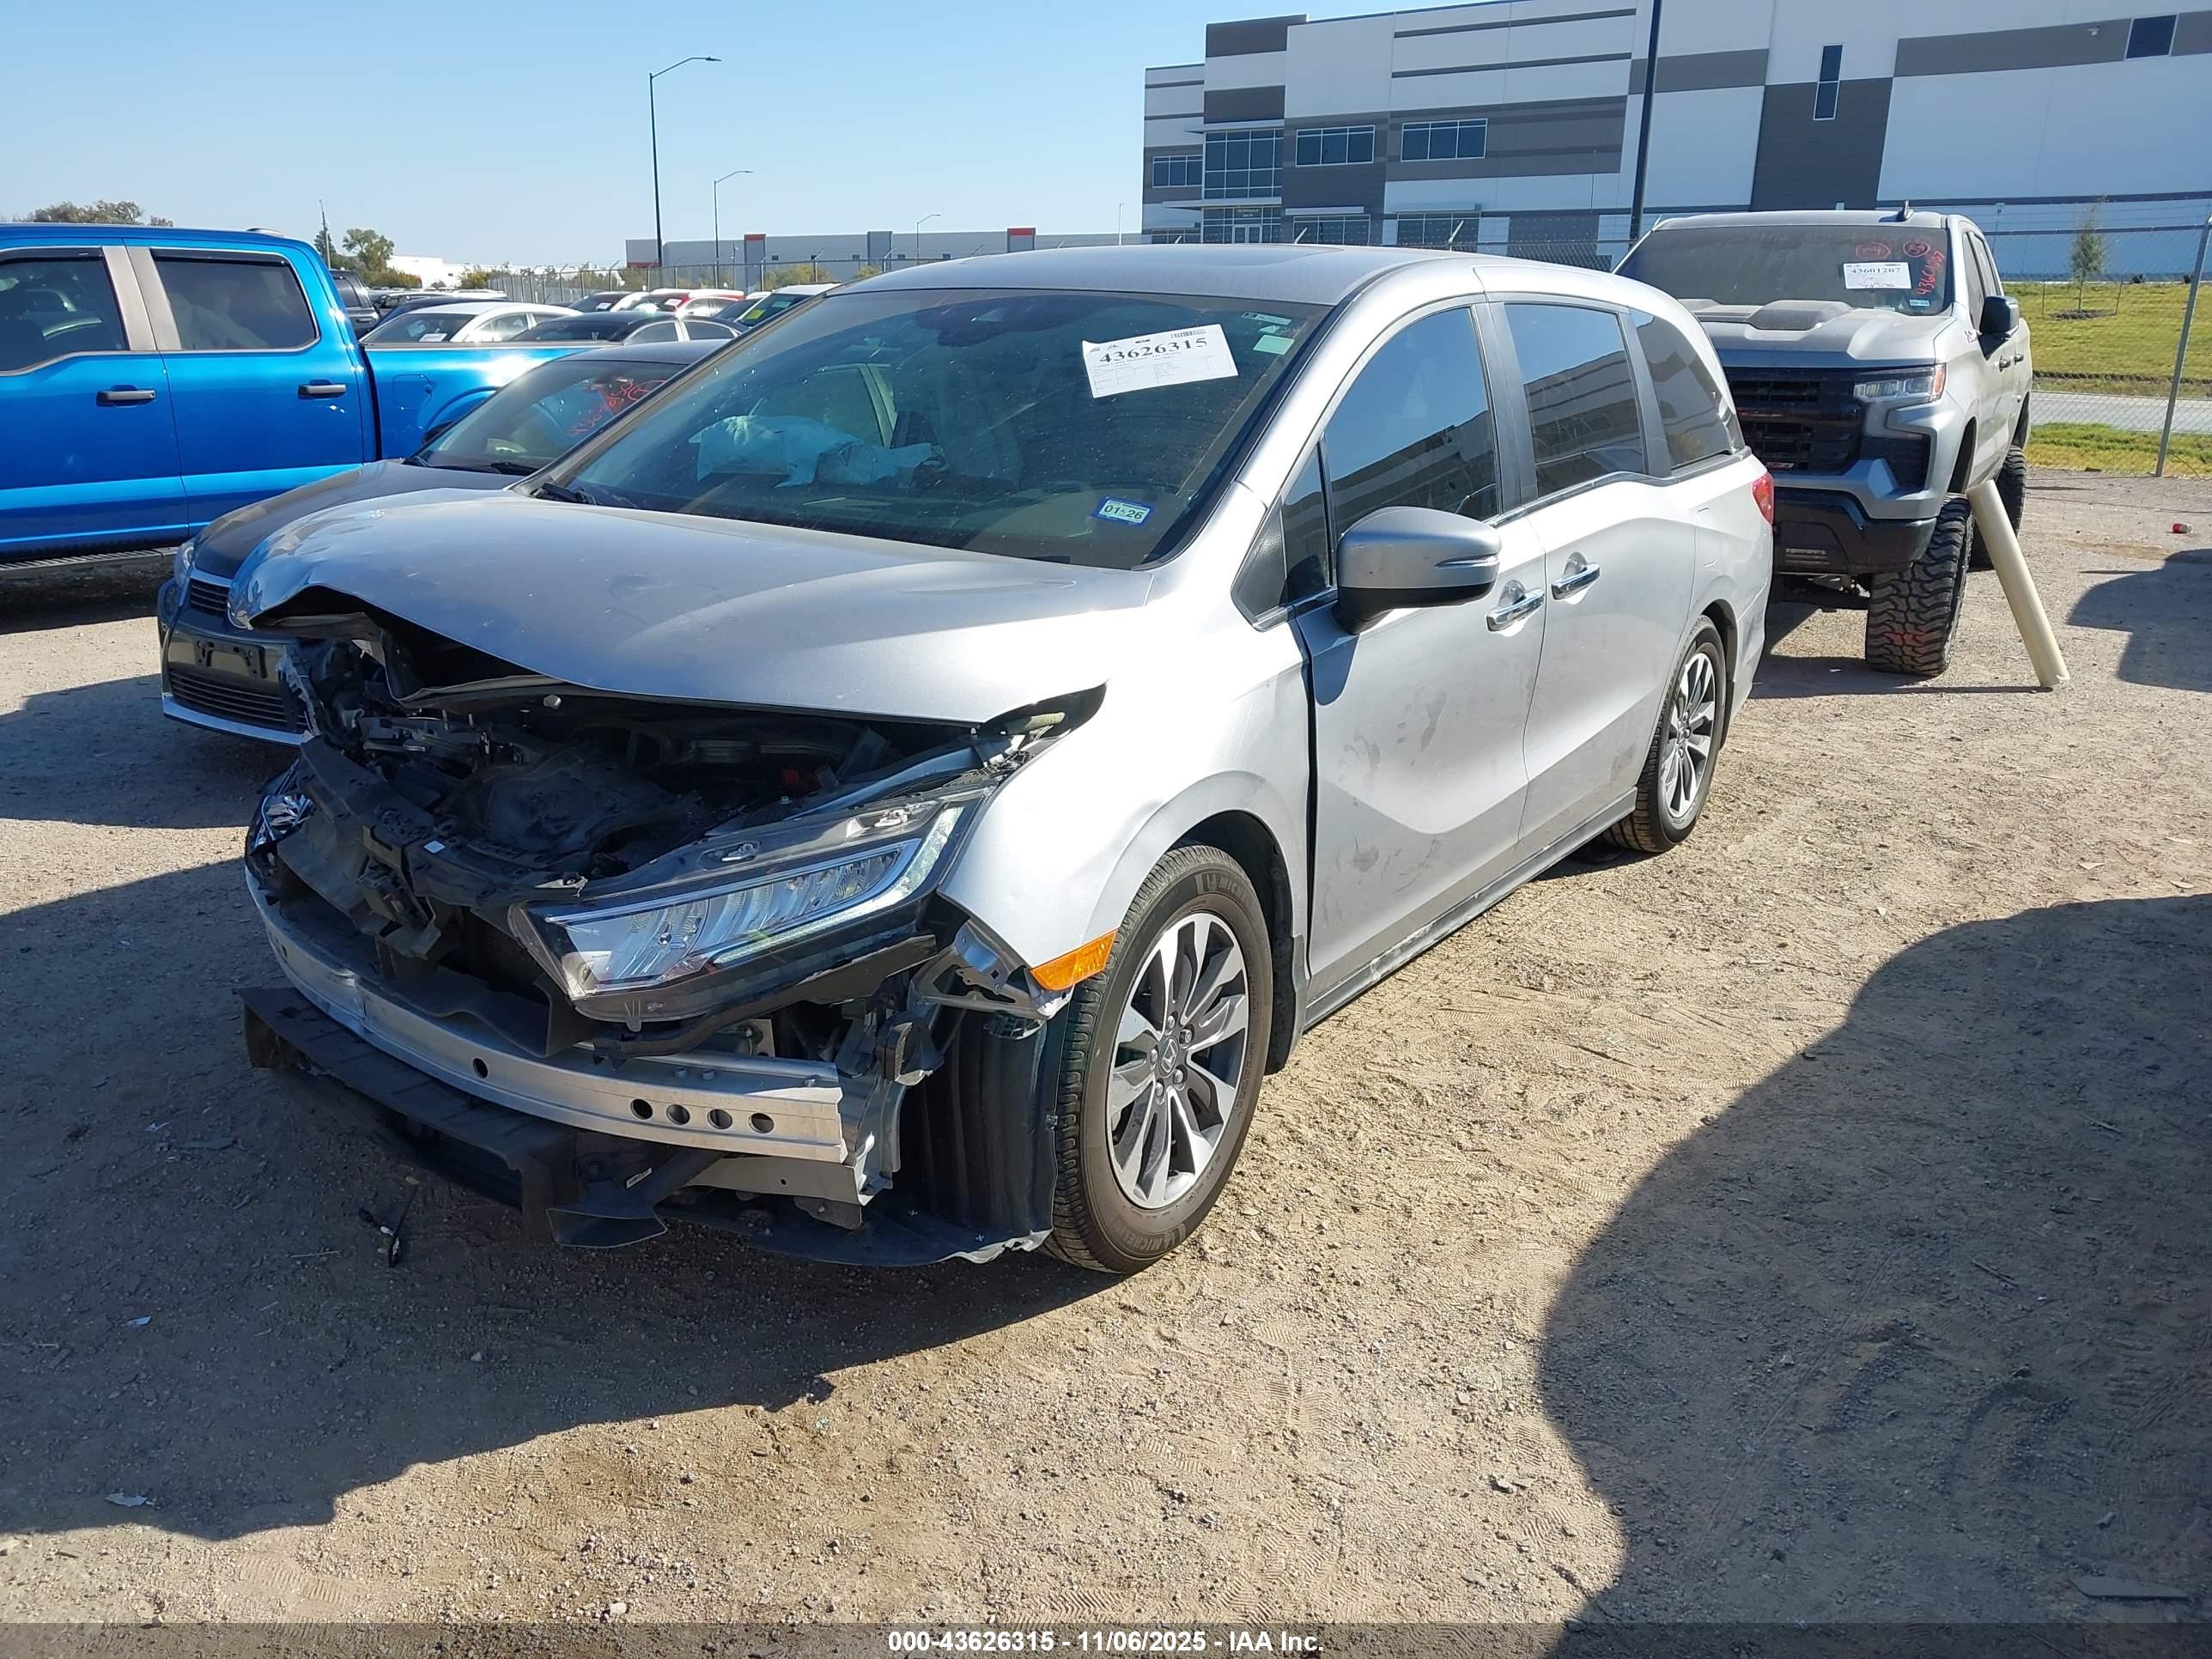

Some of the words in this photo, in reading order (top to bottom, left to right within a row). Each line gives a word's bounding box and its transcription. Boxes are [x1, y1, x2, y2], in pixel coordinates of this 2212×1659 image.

[1099, 337, 1208, 363] 43626315
[1104, 505, 1121, 514] 01
[1126, 509, 1144, 520] 26
